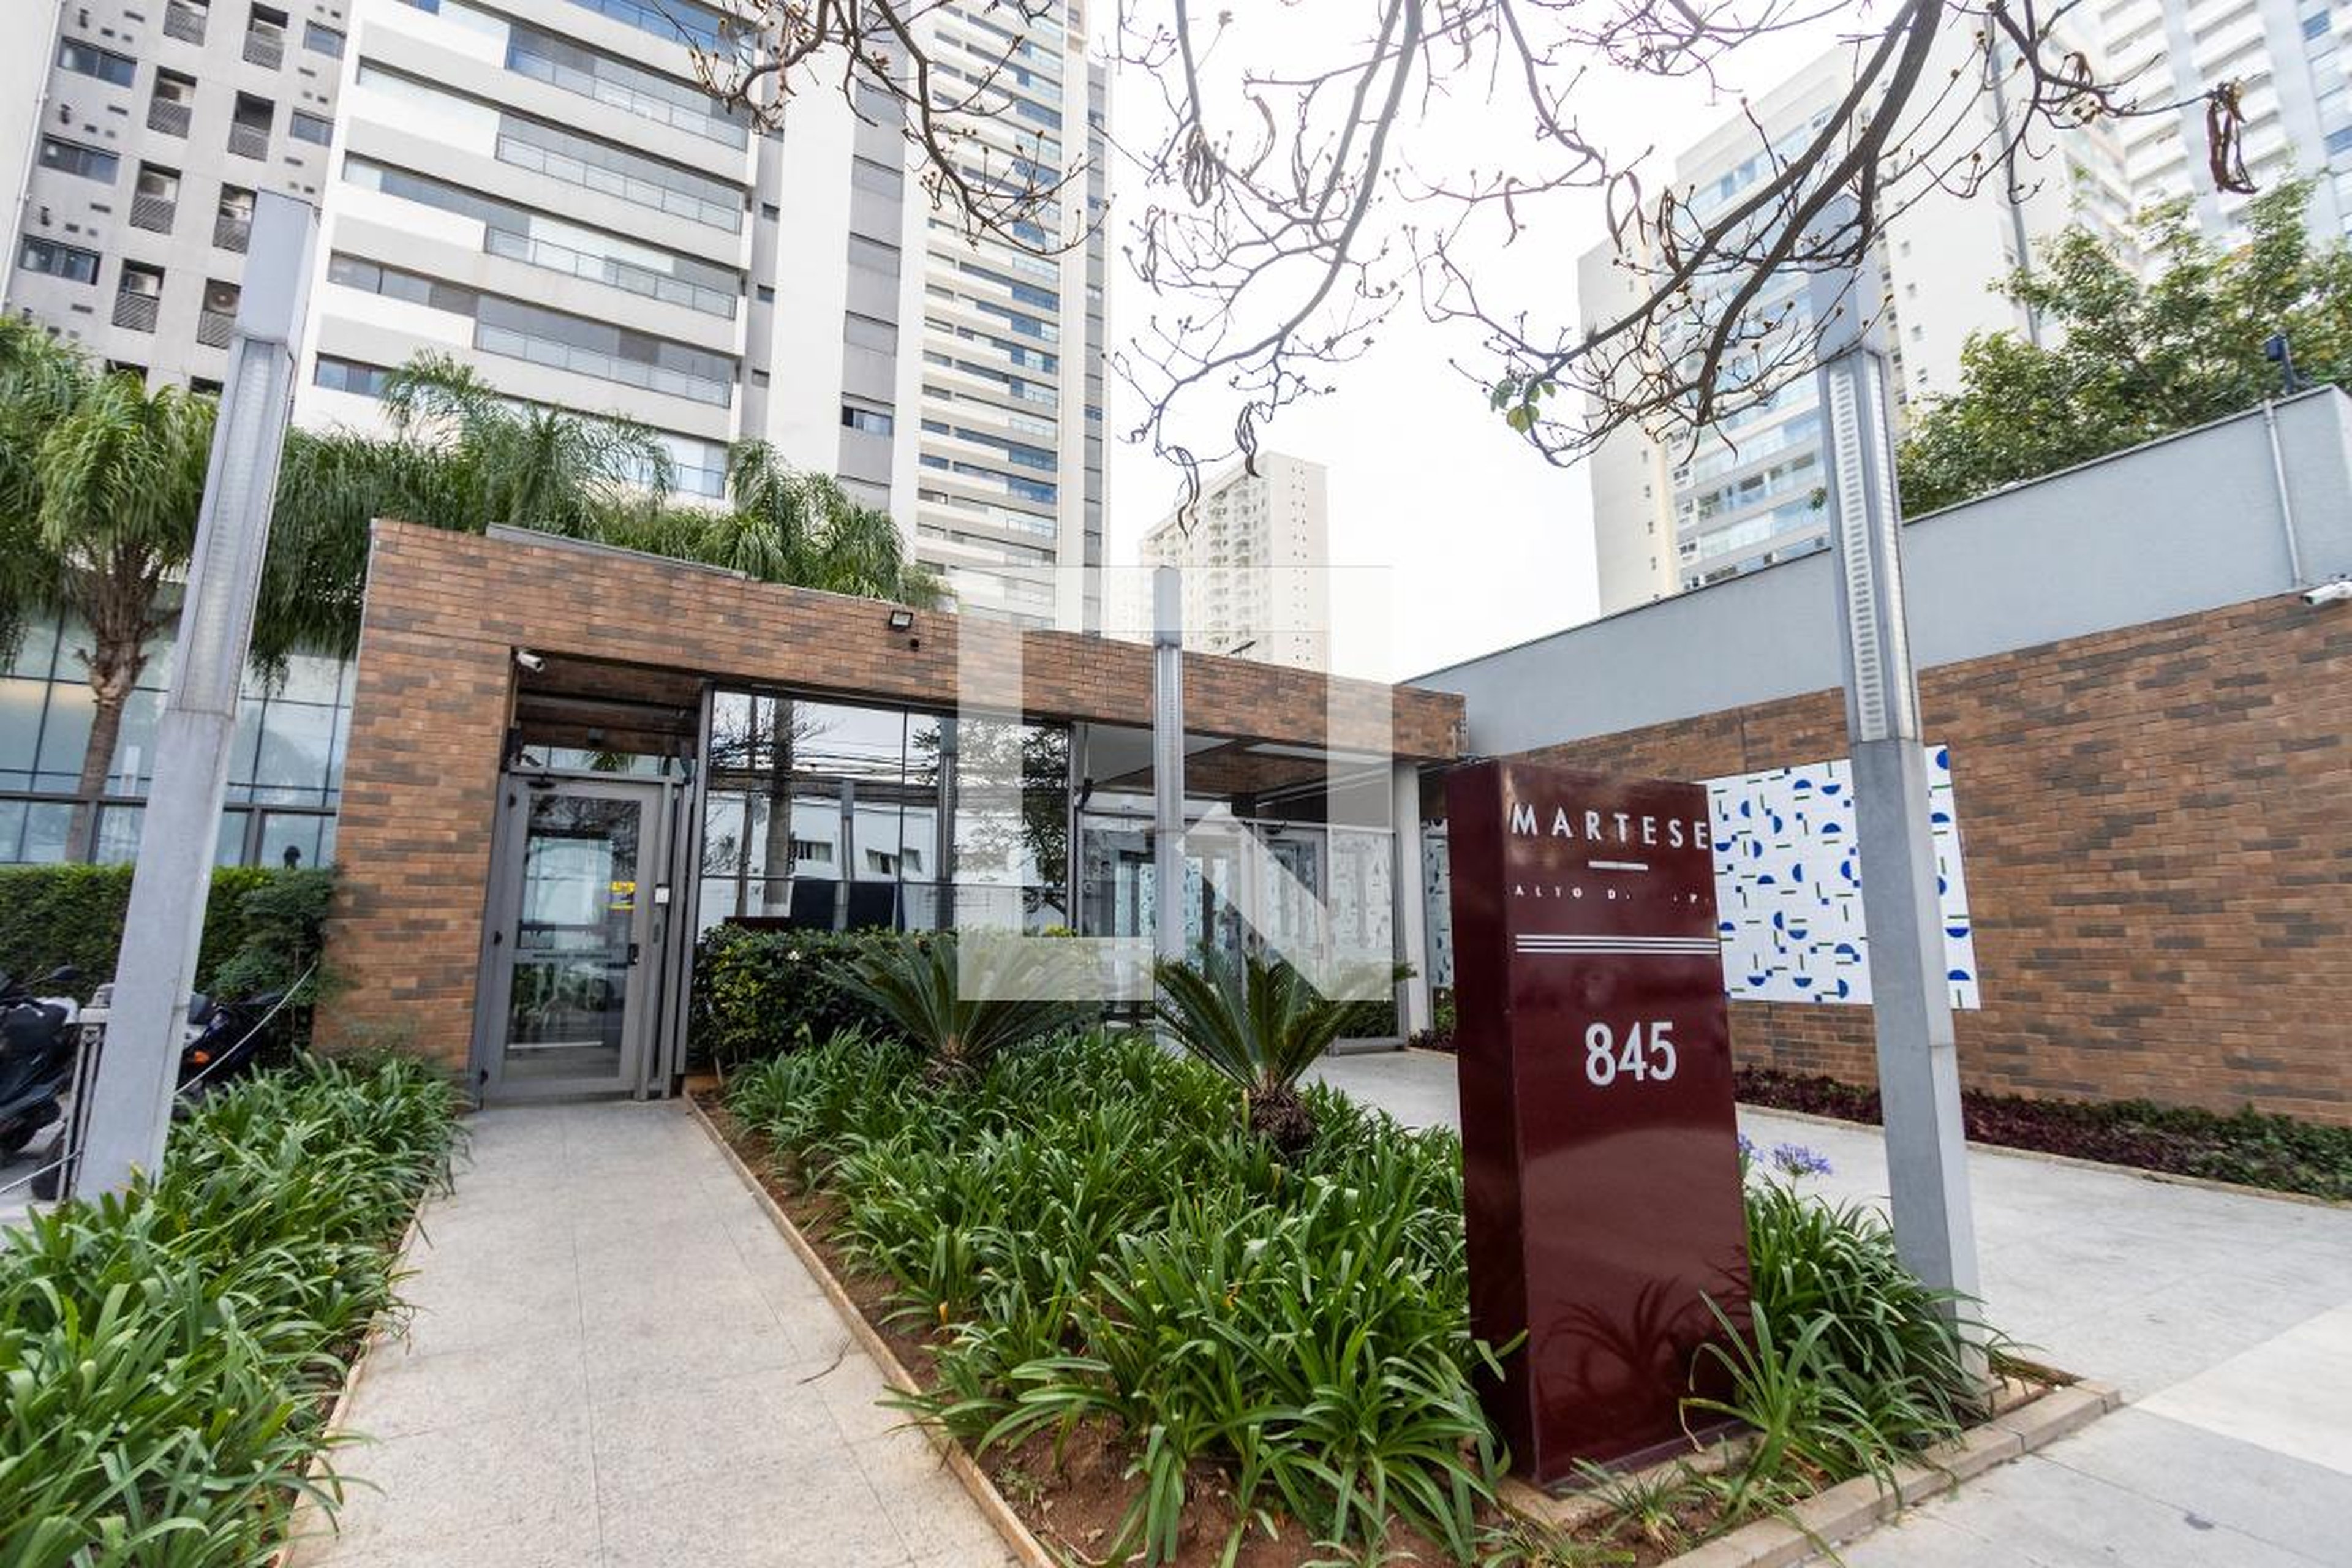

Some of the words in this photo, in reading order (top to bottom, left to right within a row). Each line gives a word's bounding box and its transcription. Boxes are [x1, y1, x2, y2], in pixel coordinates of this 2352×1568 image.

[1511, 803, 1709, 850] MARTESE
[1515, 884, 1583, 899] ALTO
[1608, 888, 1632, 900] D
[1585, 1021, 1677, 1087] 845
